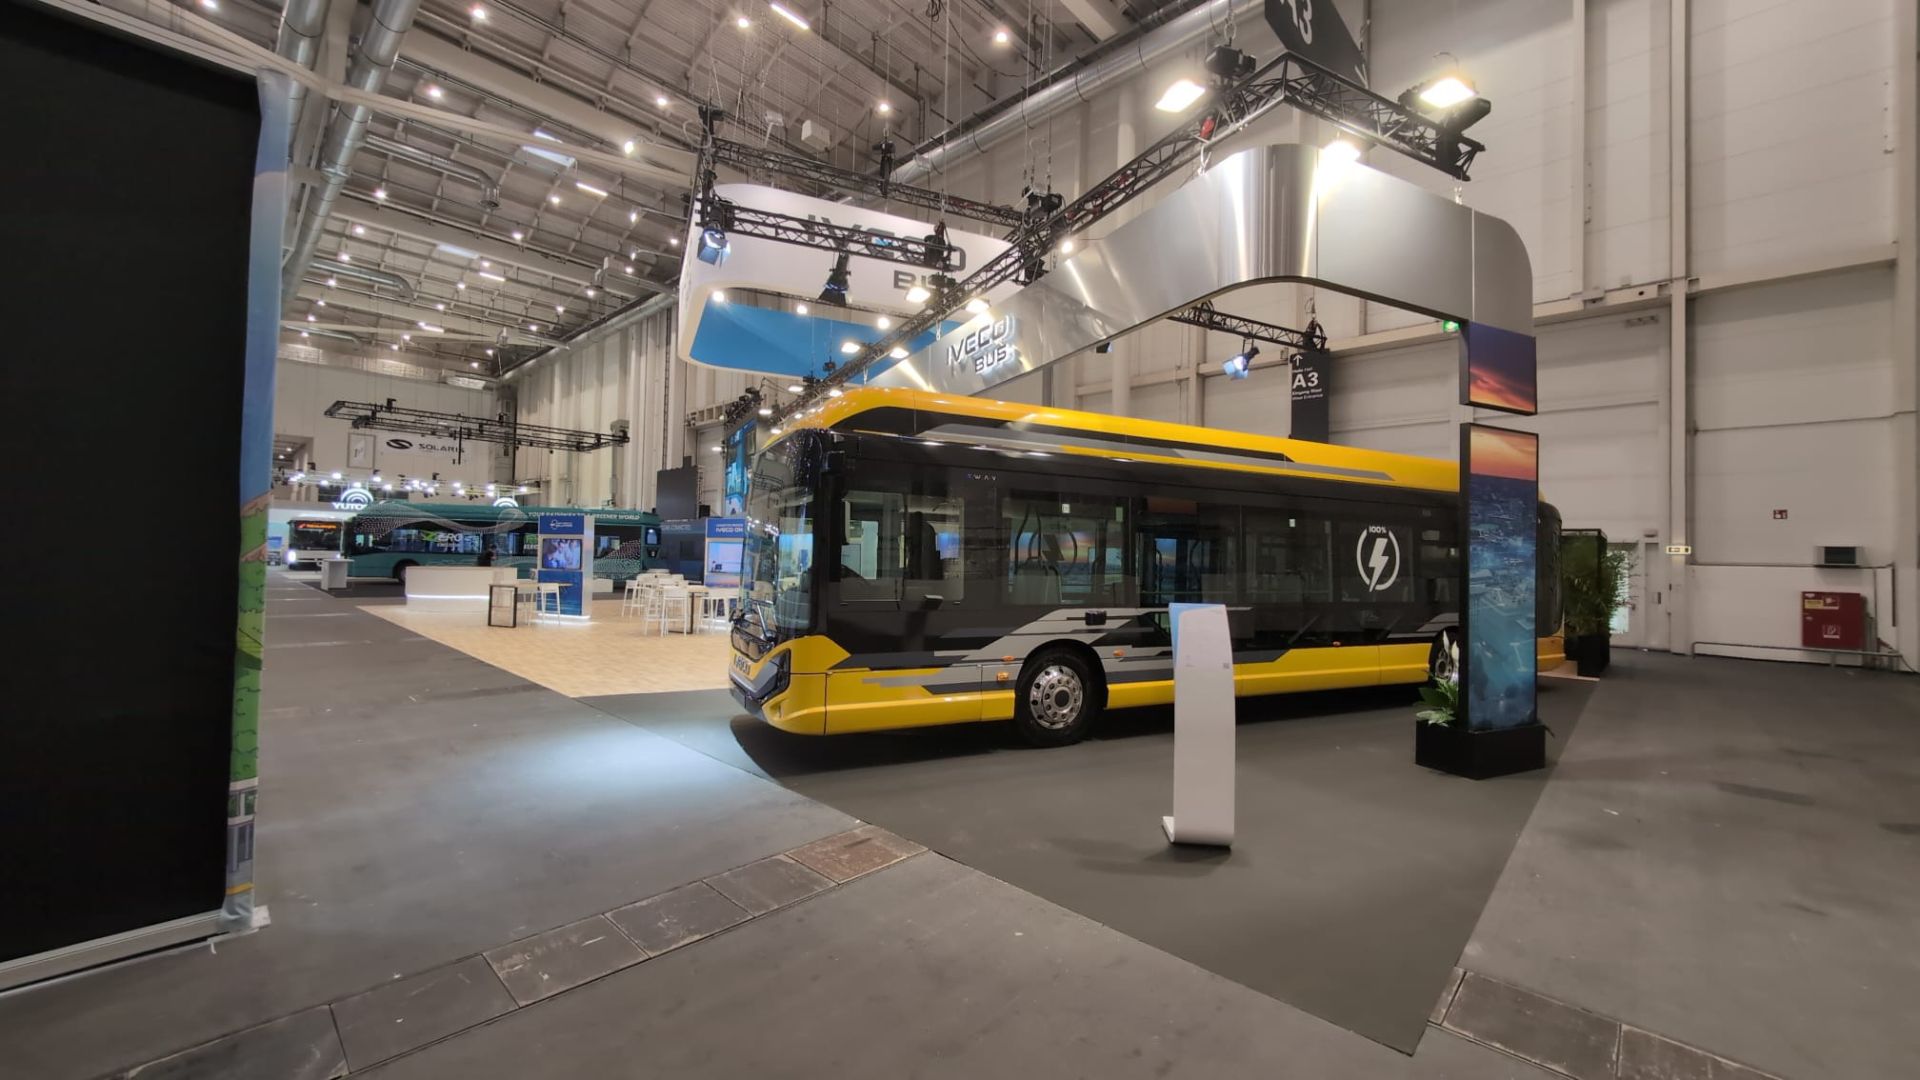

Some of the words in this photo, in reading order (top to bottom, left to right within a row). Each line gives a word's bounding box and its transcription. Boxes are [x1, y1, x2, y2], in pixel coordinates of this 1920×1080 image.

[946, 315, 1010, 366] IVECO
[975, 344, 1008, 372] BUS
[1293, 372, 1318, 389] A3
[419, 443, 465, 454] SOLARIS
[331, 501, 369, 510] YUTO
[1368, 526, 1387, 534] 100%
